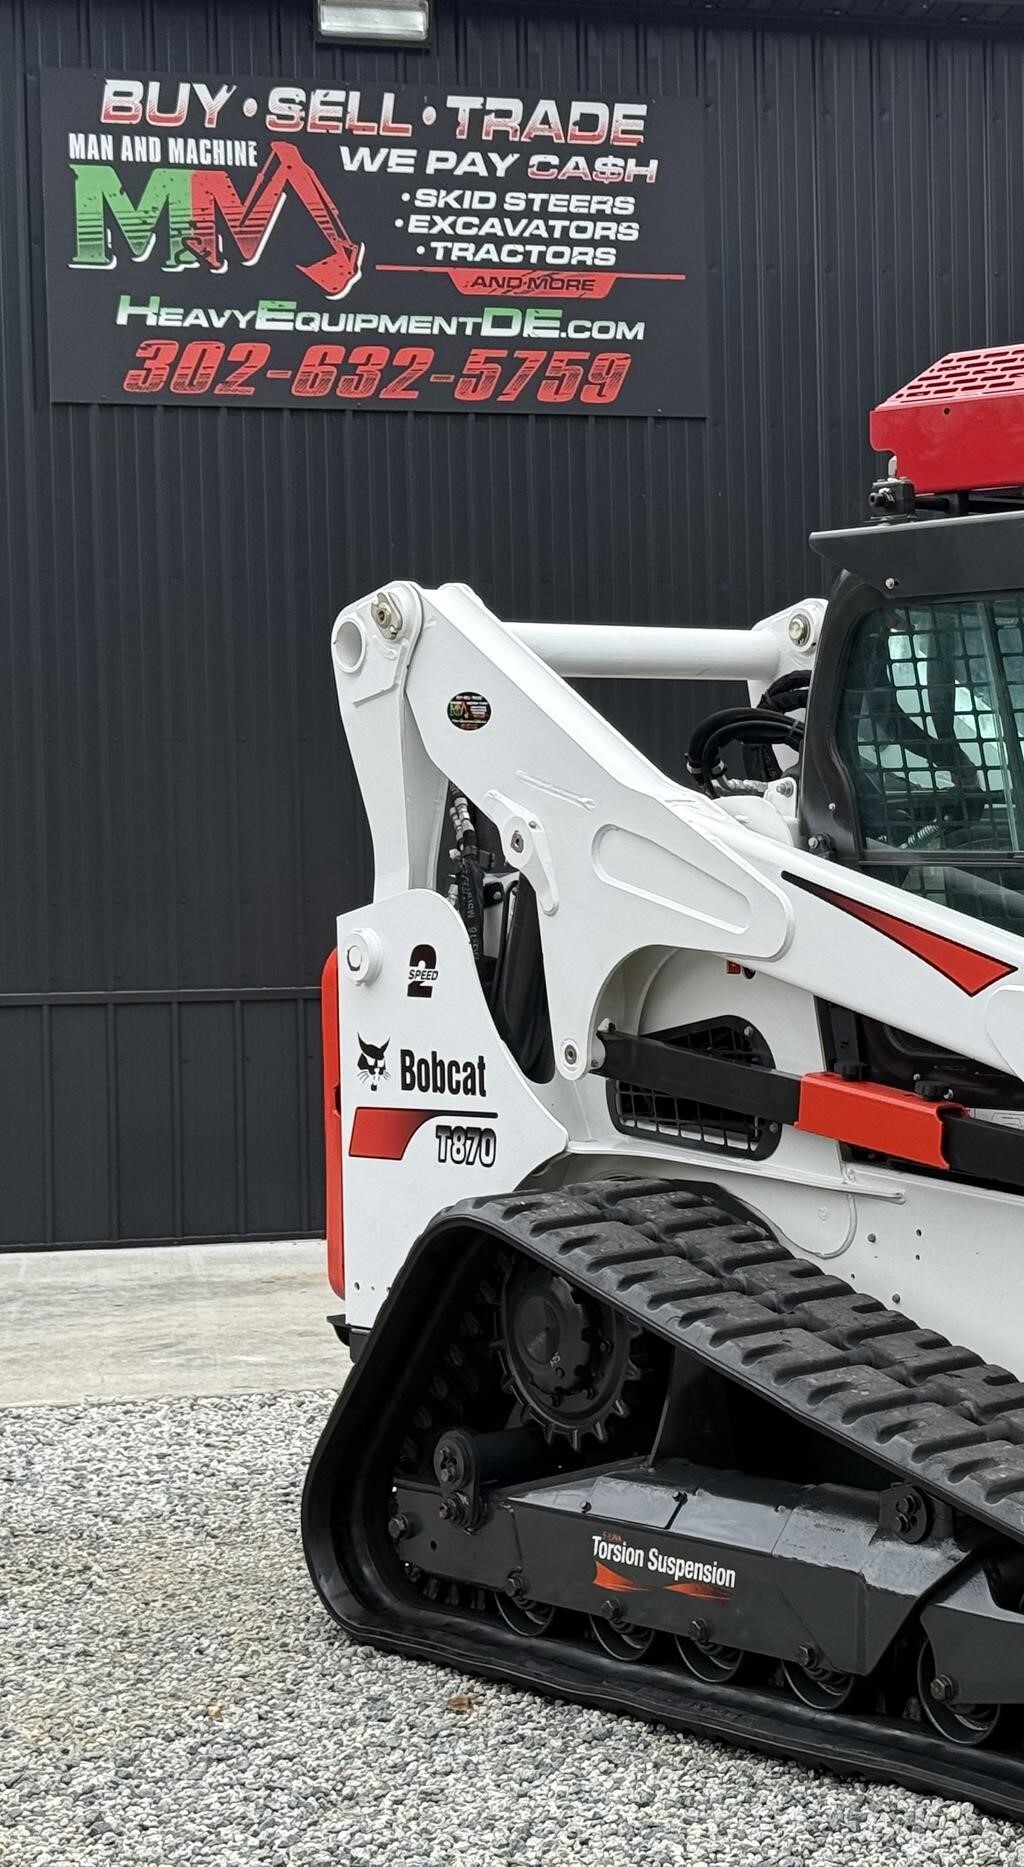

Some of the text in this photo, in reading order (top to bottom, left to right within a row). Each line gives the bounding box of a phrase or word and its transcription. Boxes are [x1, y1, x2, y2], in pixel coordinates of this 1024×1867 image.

[100, 79, 648, 147] BUY SELL TRADE
[68, 132, 258, 167] MAN AND MACHINE
[340, 146, 659, 184] WE PAY CA$H
[414, 188, 636, 215] SKID STEERS
[407, 214, 640, 241] EXCAVATORS
[430, 241, 617, 266] TRACTORS
[123, 339, 632, 404] 302-632-5759
[408, 969, 439, 981] SPEED
[400, 1048, 487, 1097] Bobcat
[436, 1124, 497, 1168] T870
[592, 1535, 737, 1588] Torsion Suspension
